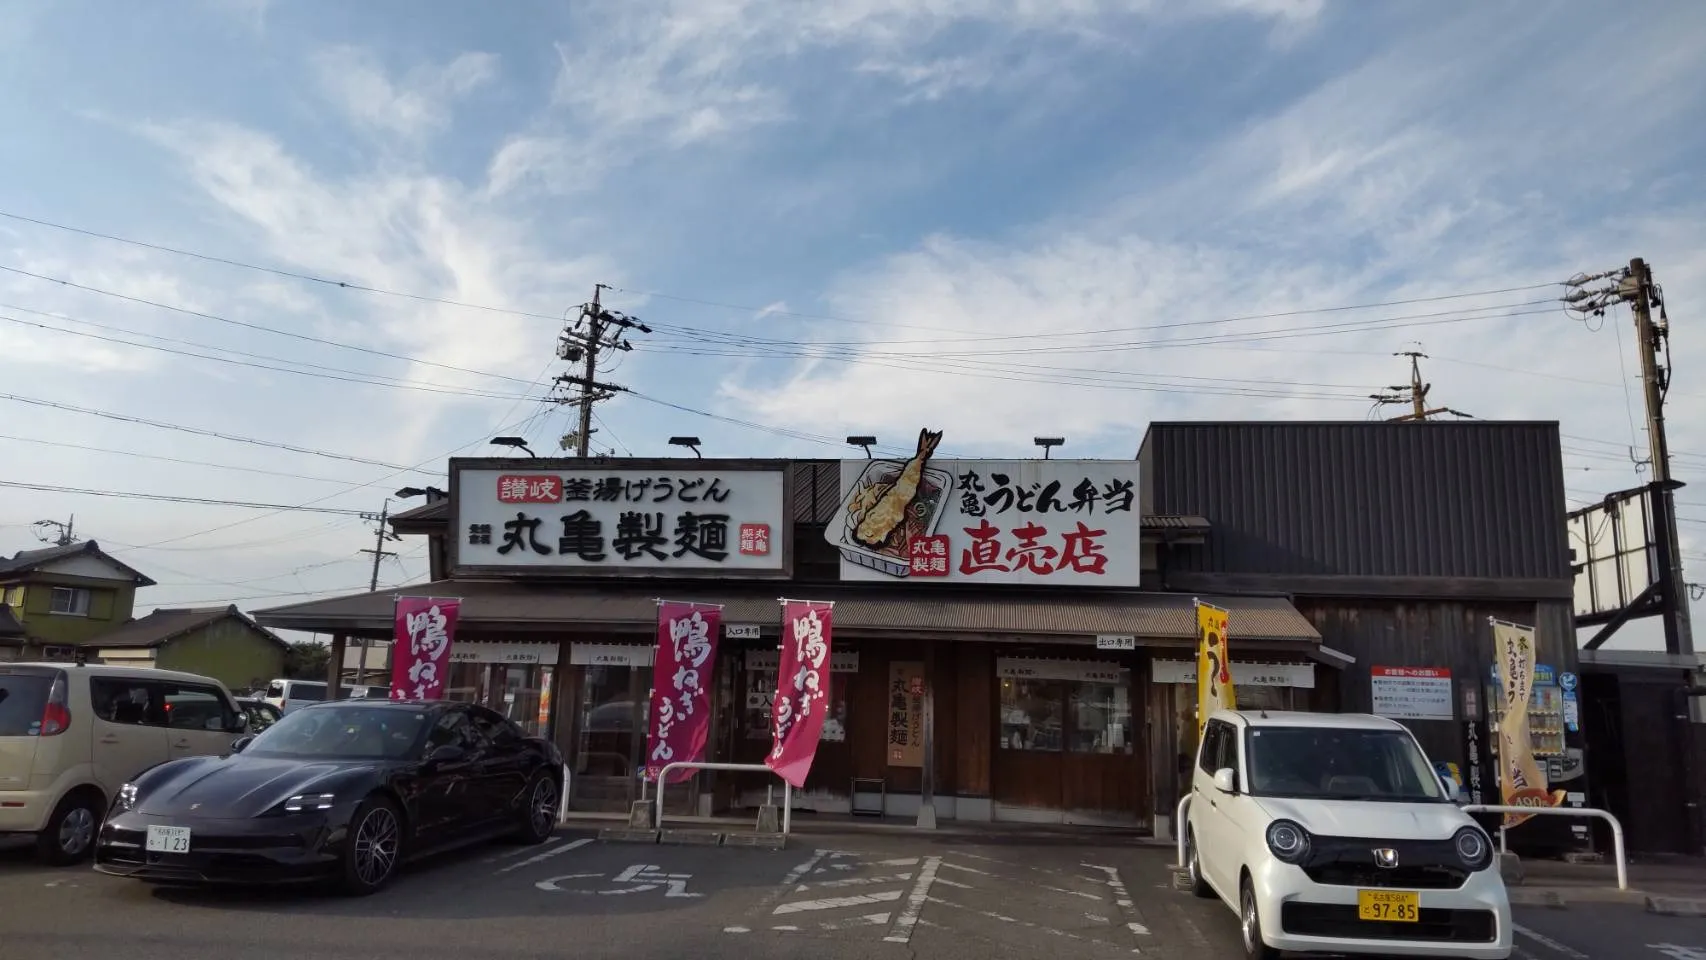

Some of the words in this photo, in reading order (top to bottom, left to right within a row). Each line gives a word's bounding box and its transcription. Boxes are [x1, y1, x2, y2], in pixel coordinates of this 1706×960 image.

[500, 478, 559, 501] 讃岐
[562, 477, 731, 503] 釜揚げうどん
[982, 472, 1135, 516] うどん弁当
[496, 508, 731, 562] 丸亀製麺
[957, 518, 1108, 576] 直売店
[727, 626, 760, 637] 入口専用
[1098, 637, 1134, 648] 出口専用
[669, 610, 712, 722] 鴨ねぎ
[651, 696, 675, 761] うどん
[1373, 903, 1415, 920] 97-85
